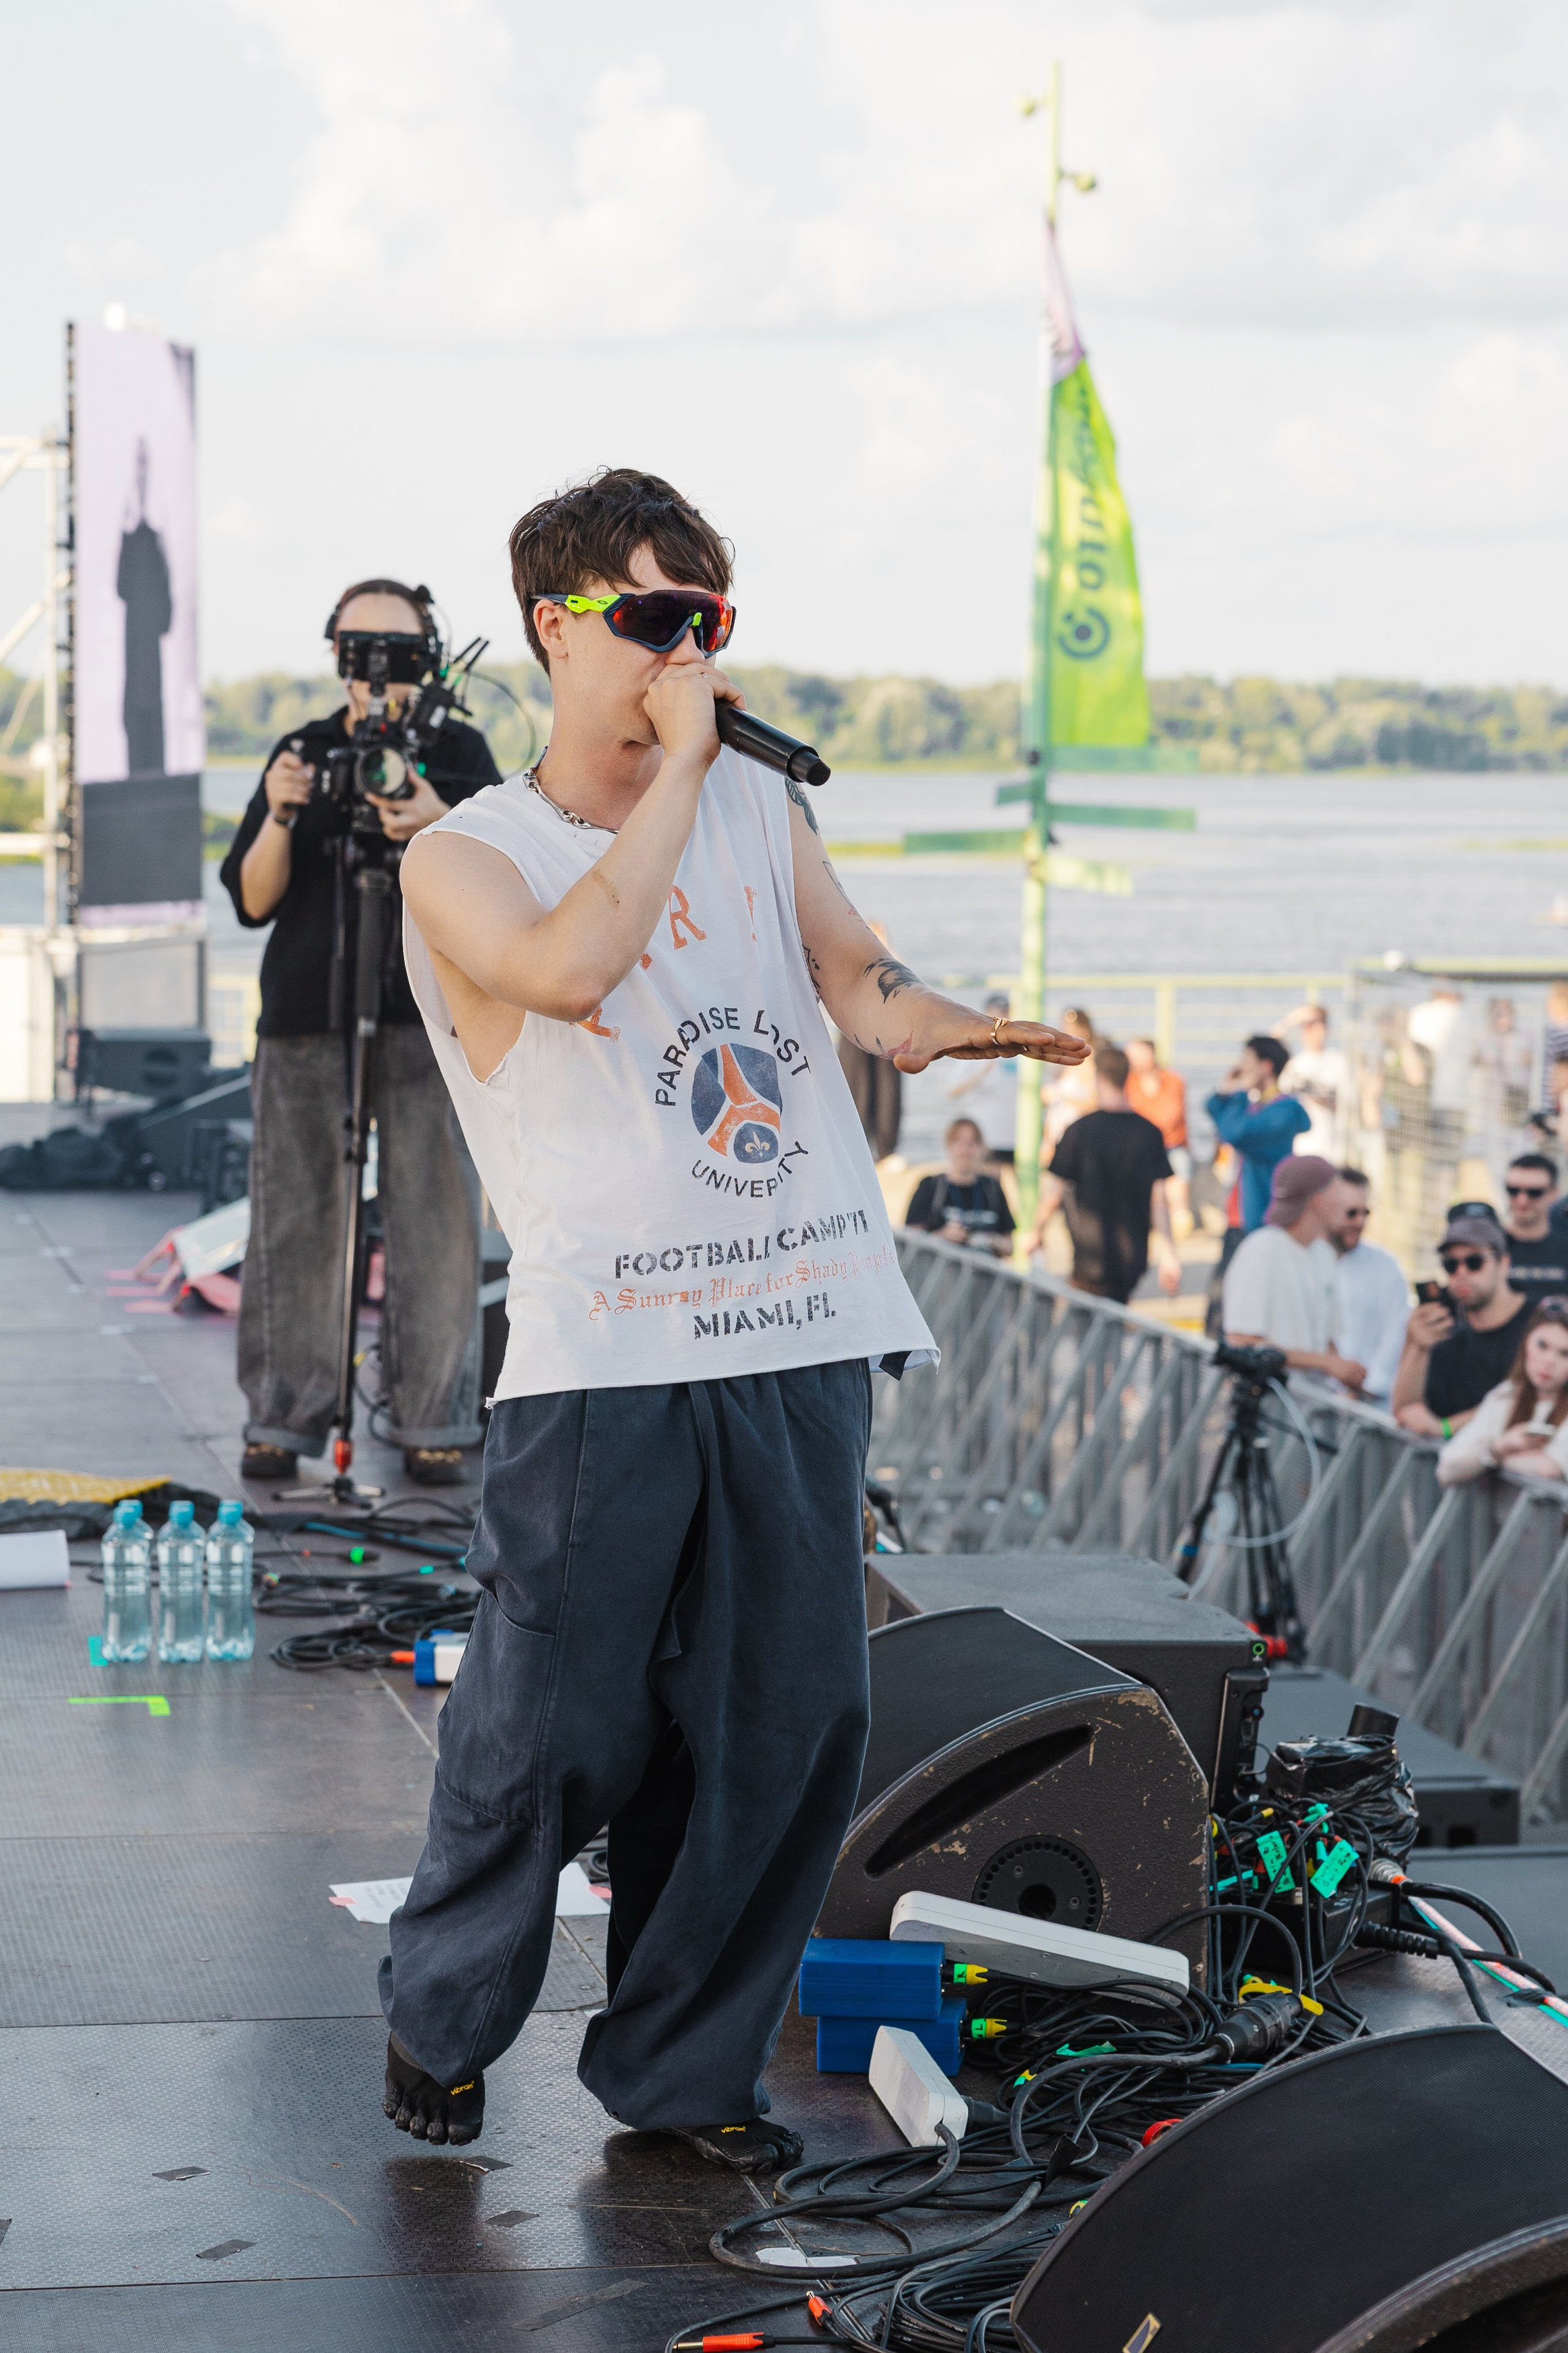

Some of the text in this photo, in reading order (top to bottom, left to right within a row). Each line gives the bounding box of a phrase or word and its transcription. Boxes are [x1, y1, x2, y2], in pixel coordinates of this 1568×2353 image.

[588, 1290, 612, 1321] A
[708, 1277, 762, 1309] Place
[766, 1271, 793, 1294] for
[795, 1258, 848, 1288] Shady
[693, 1299, 802, 1340] MIAMI,
